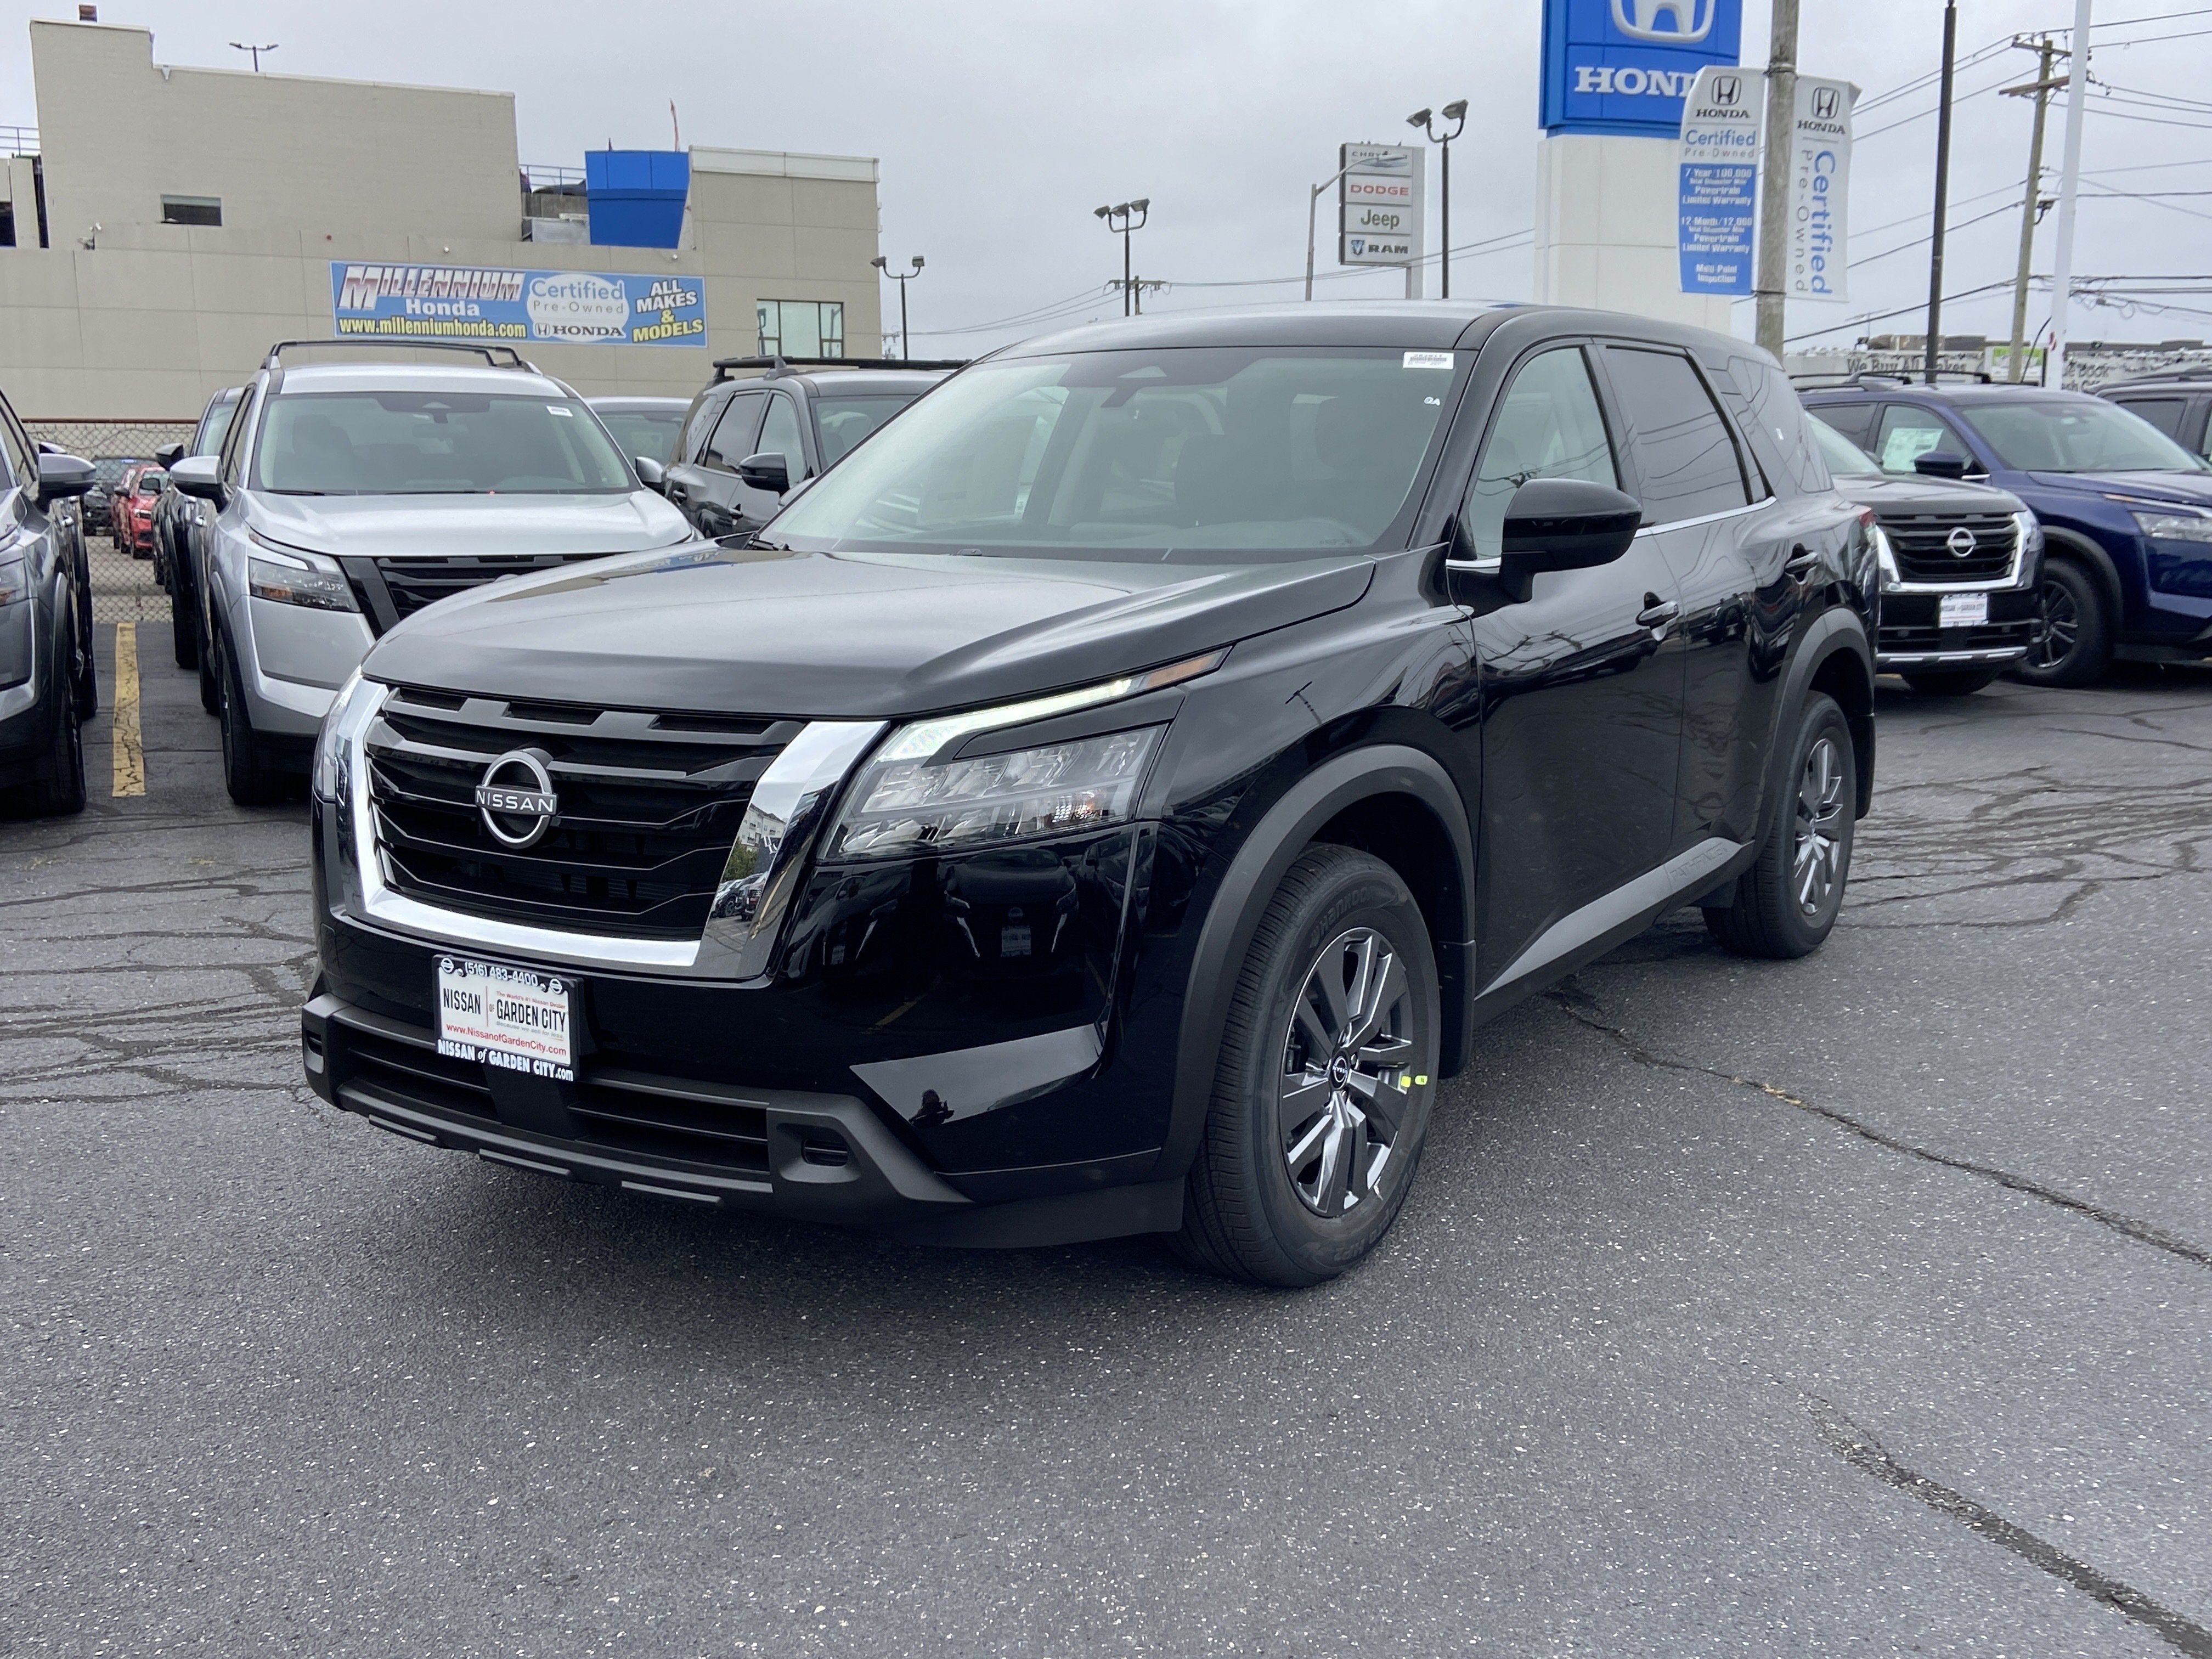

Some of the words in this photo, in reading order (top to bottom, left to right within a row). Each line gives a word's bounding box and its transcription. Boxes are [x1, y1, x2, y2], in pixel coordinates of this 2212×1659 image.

[1574, 66, 1695, 98] HON
[1696, 109, 1751, 118] HONDA
[1685, 129, 1756, 146] Certified
[1797, 120, 1846, 135] HONDA
[1350, 184, 1409, 196] DODGE
[1361, 209, 1400, 230] Jeep
[1796, 149, 1813, 292] Pre-Owned
[1811, 150, 1836, 295] Certified
[1368, 244, 1408, 254] RAM
[337, 266, 526, 311] MILLENNIUM
[532, 280, 623, 300] Certified
[650, 279, 682, 297] ALL
[405, 298, 481, 317] Honda
[533, 301, 624, 314] Pre-Owned
[636, 291, 697, 313] MAKES
[338, 316, 527, 338] www.millenniumhonda.com
[661, 309, 675, 324] &
[552, 325, 625, 336] HONDA
[632, 319, 704, 343] MODELS
[476, 789, 553, 812] NISSAN
[465, 962, 487, 977] (516)
[490, 967, 538, 987] 483-4400
[443, 988, 481, 1015] NISSAN
[496, 999, 538, 1026] GARDEN
[541, 1008, 566, 1032] CITY
[447, 1023, 567, 1056] www.NissanofGardenCity.com
[438, 1039, 475, 1061] NISSAN
[478, 1048, 487, 1063] of
[489, 1050, 530, 1073] GARDEN
